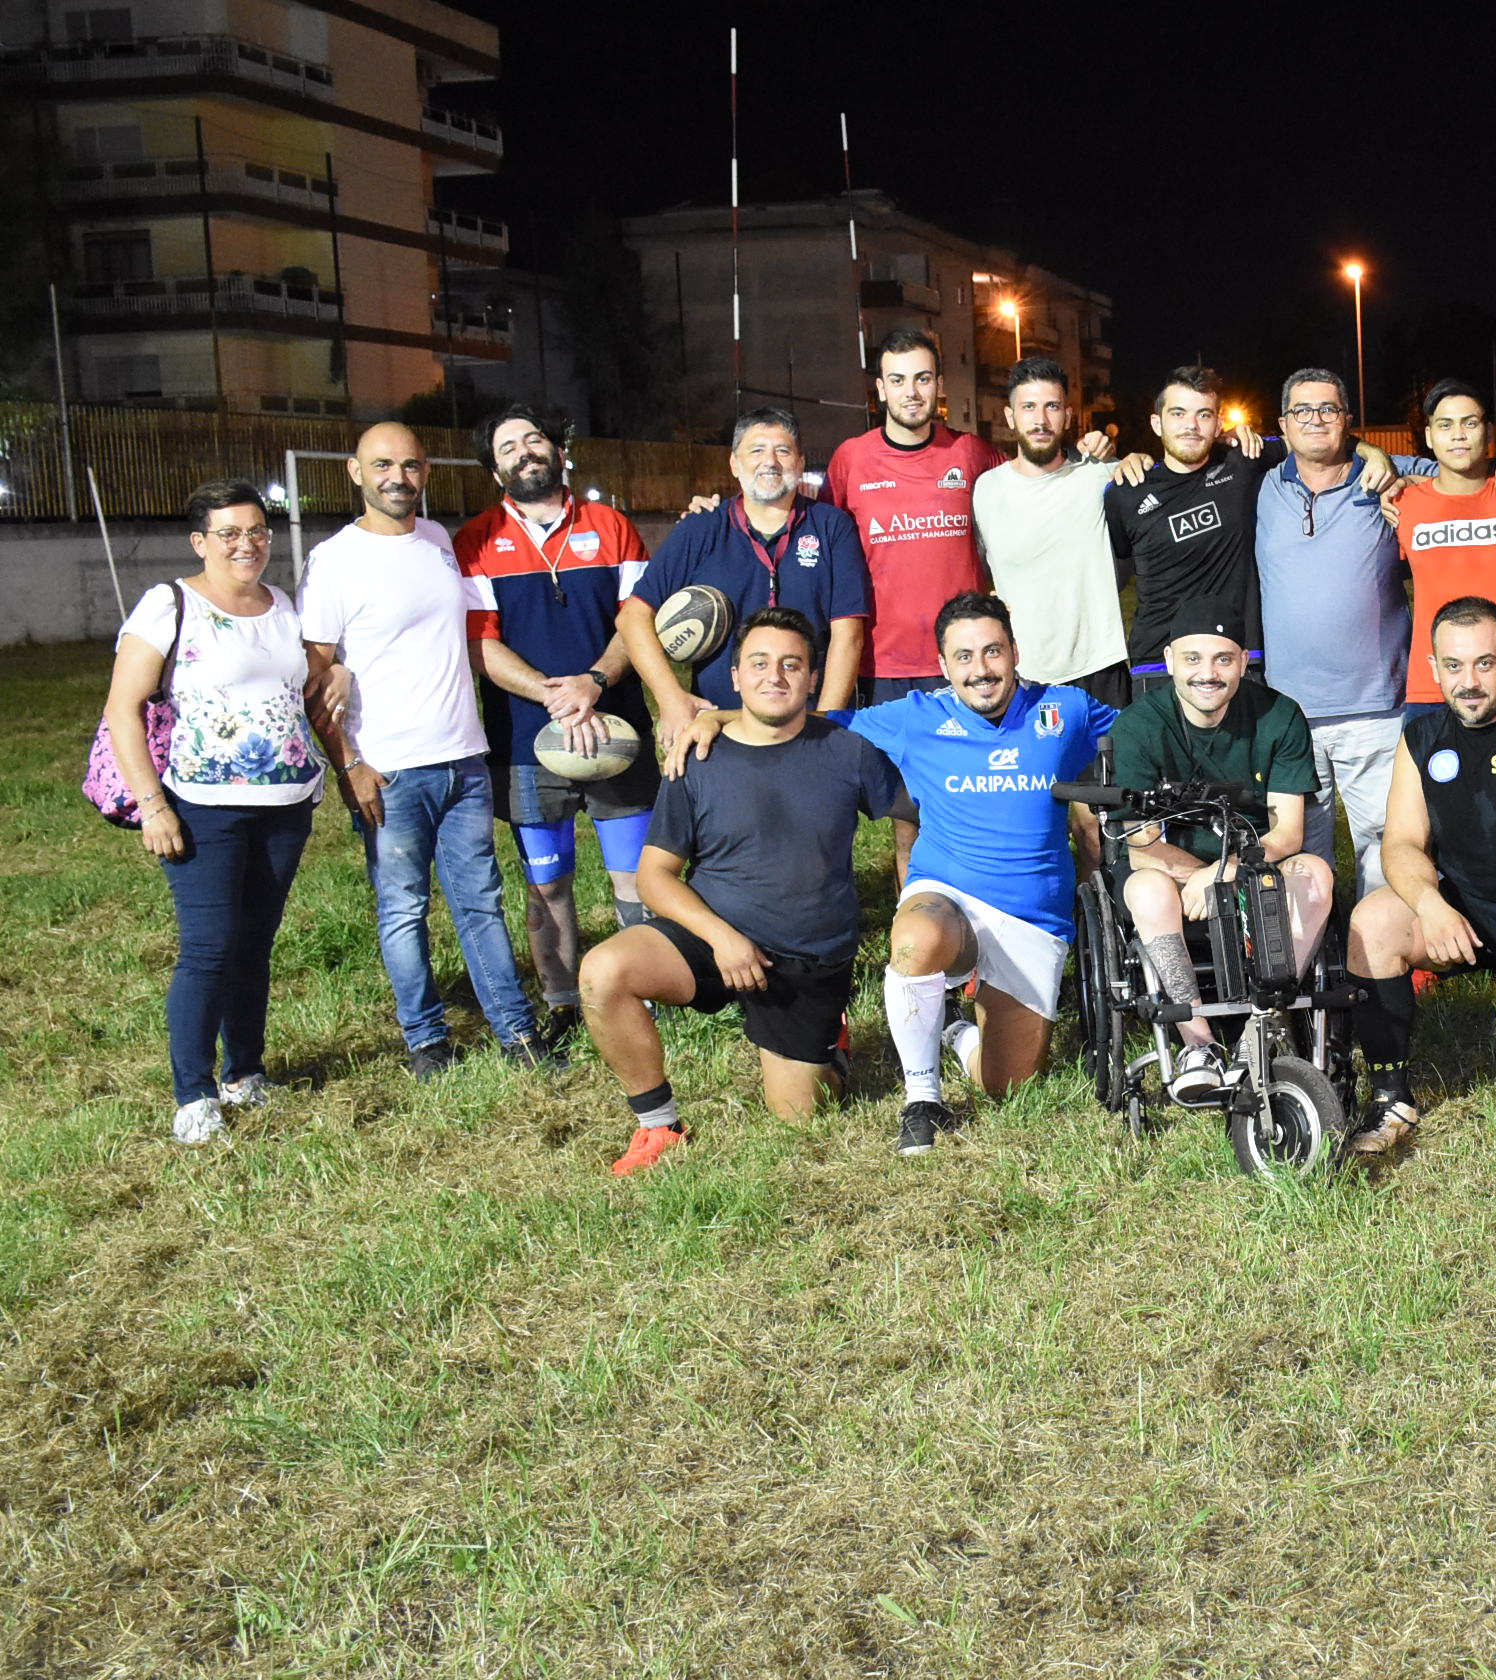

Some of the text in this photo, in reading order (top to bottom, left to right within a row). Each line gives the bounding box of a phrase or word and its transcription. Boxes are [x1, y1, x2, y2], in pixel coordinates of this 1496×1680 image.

[860, 480, 896, 491] macron
[889, 510, 968, 532] Aberdeen
[1179, 509, 1214, 535] AIG
[870, 529, 967, 545] GLOBAL ASSET MANAGEMENT
[666, 627, 696, 655] Kipst
[936, 728, 968, 736] adidas
